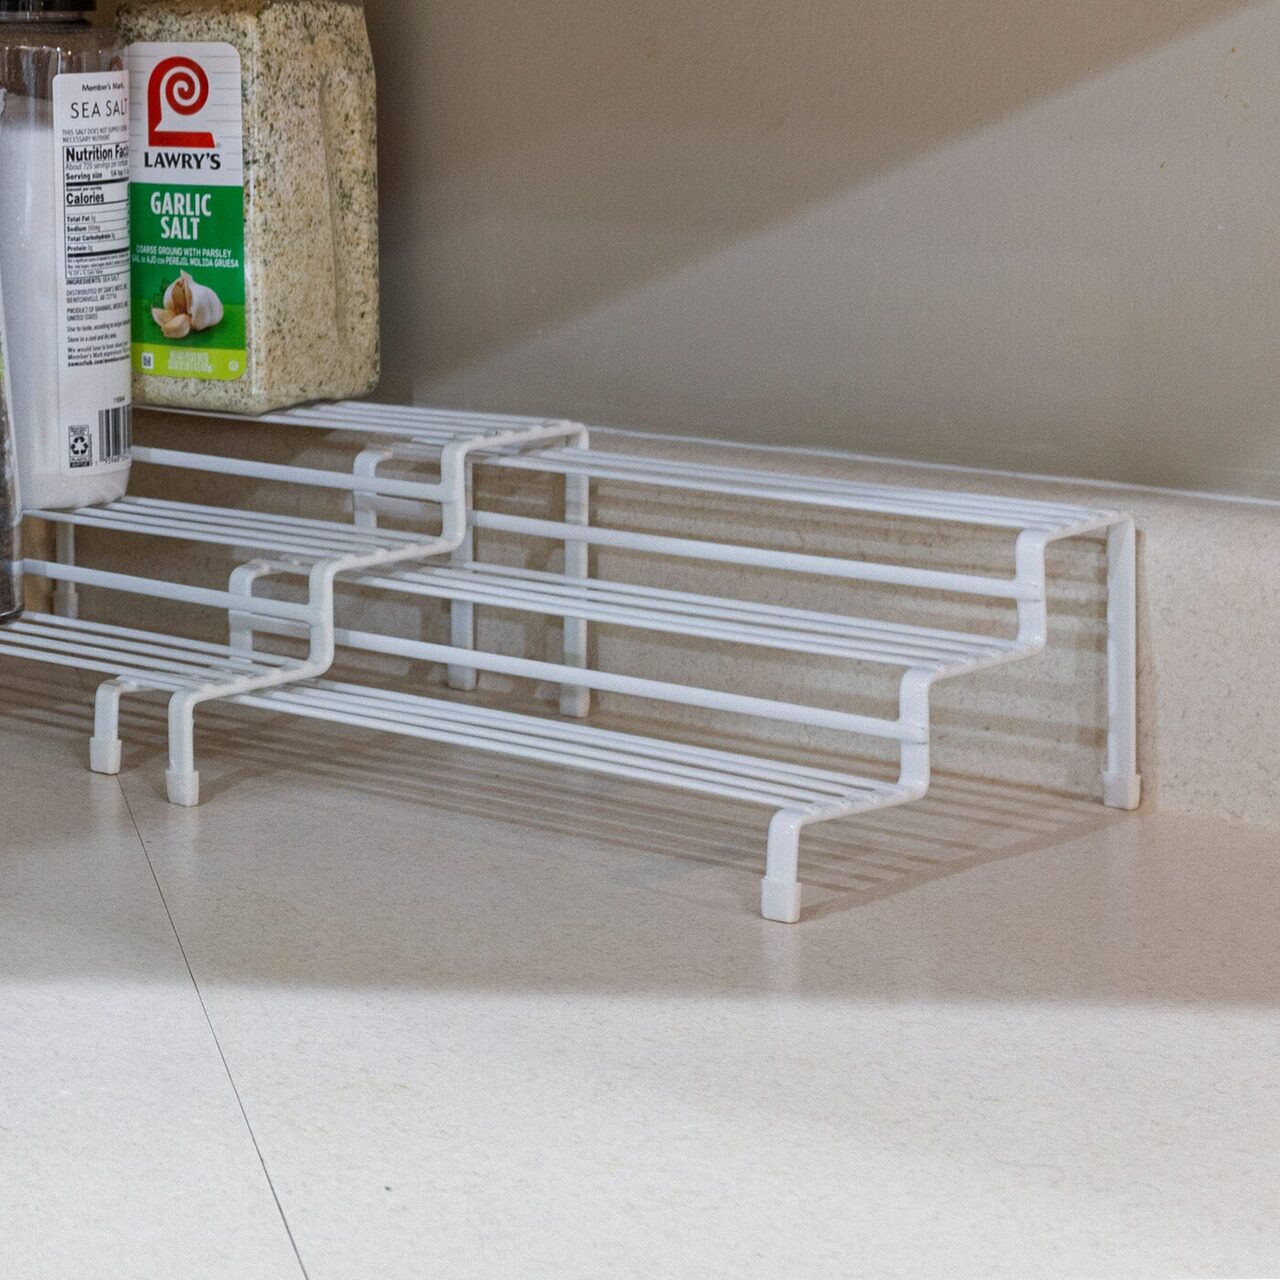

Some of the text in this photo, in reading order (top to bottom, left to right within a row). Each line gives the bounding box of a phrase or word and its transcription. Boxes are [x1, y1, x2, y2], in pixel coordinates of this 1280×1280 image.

[70, 98, 128, 119] SEA SALT
[66, 145, 113, 161] Nutrition
[143, 151, 221, 170] LAWRY'S
[66, 172, 90, 181] Serving
[66, 191, 104, 204] Calories
[150, 191, 212, 217] GARLIC
[160, 216, 200, 240] SALT
[202, 248, 232, 258] PARSLEY
